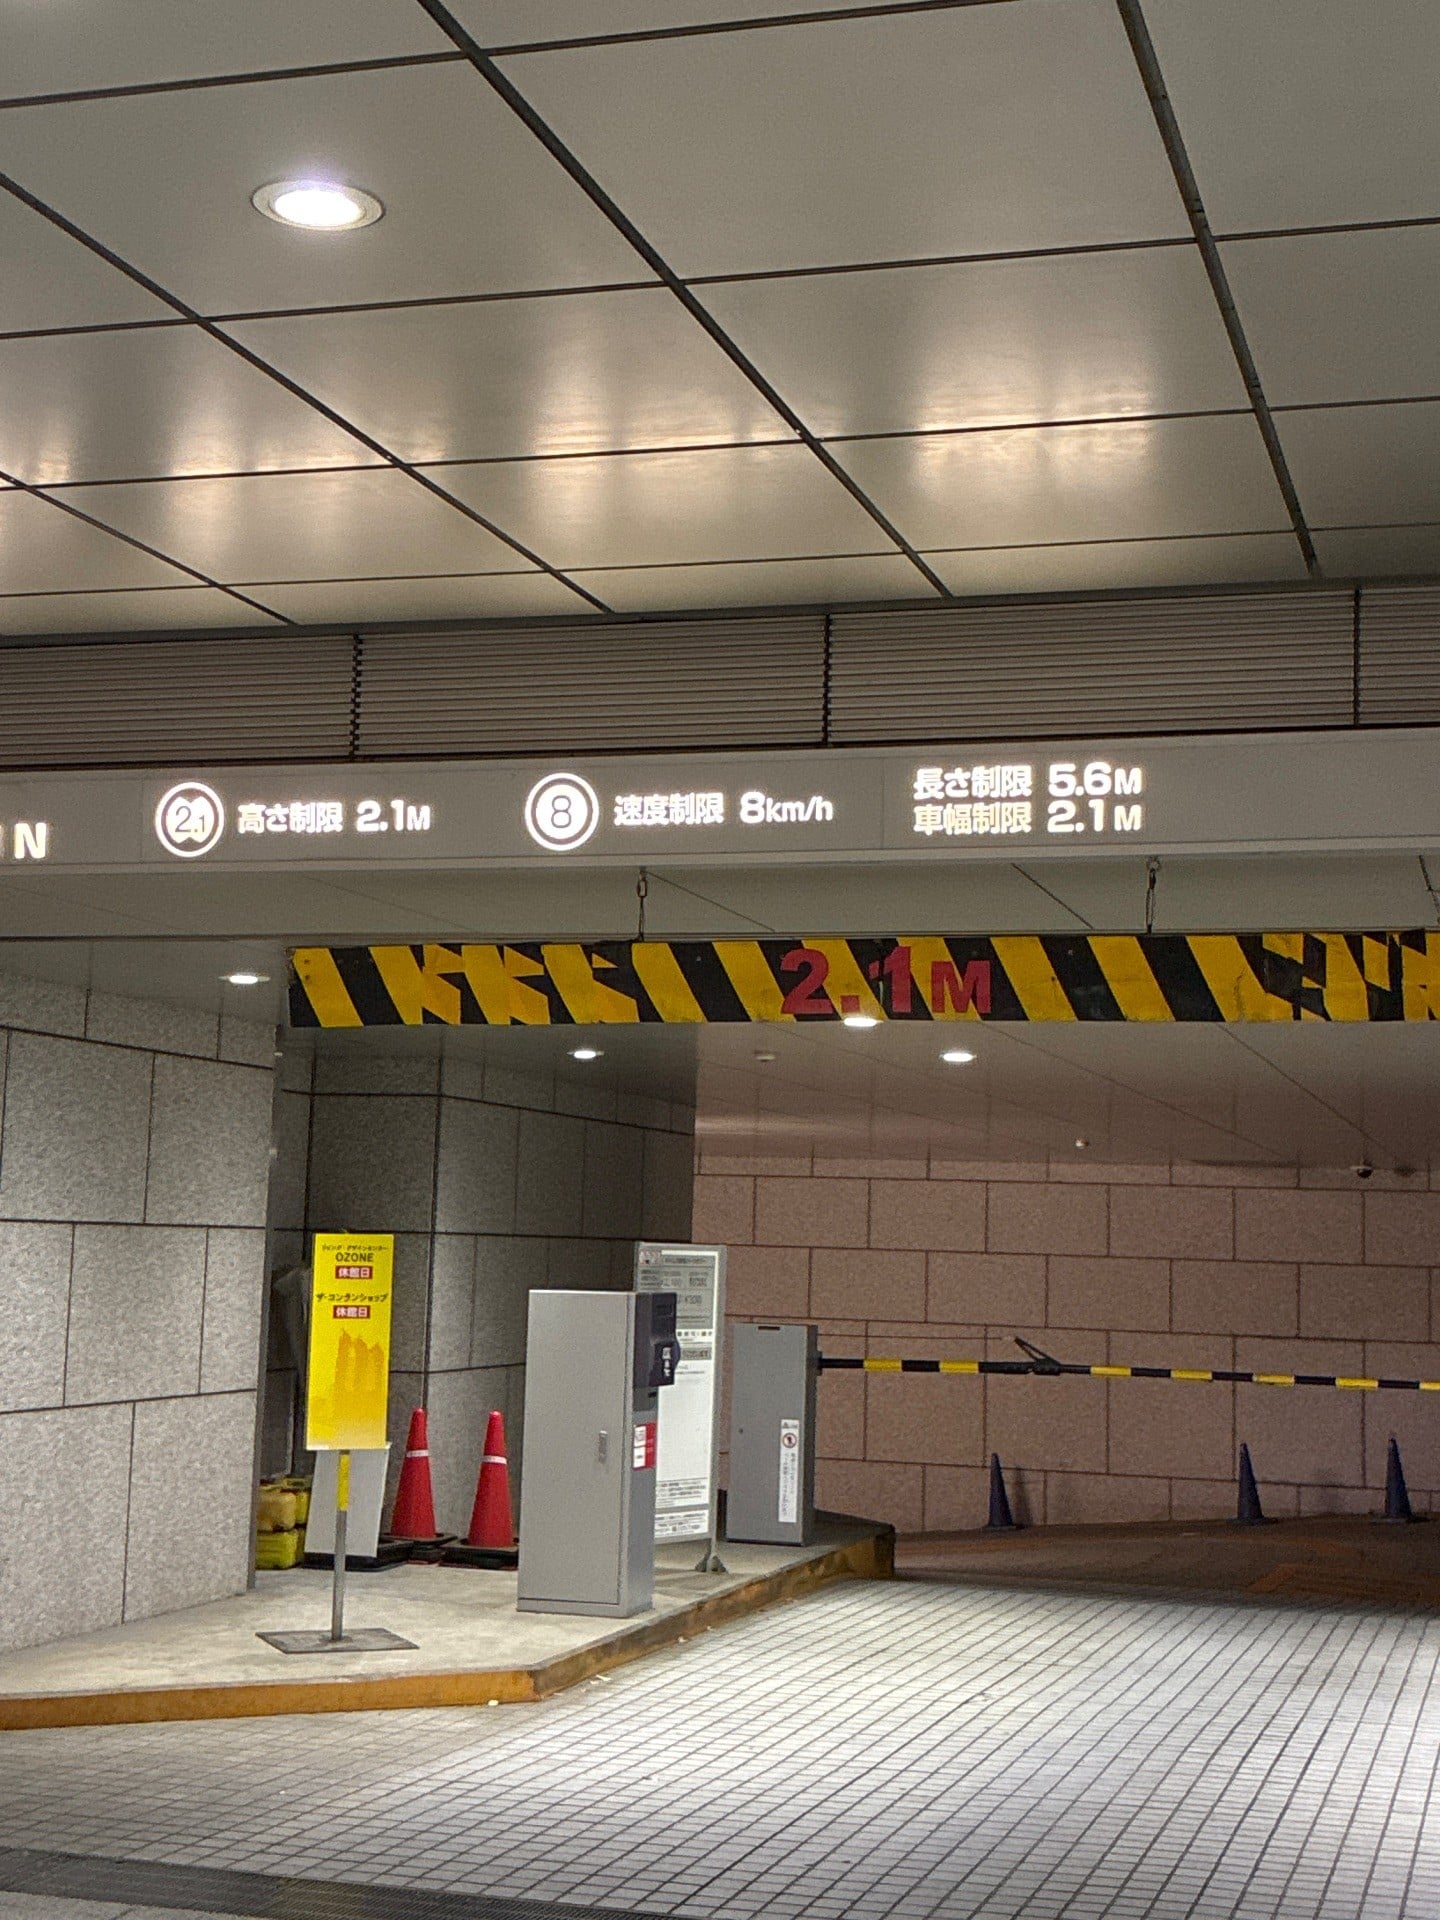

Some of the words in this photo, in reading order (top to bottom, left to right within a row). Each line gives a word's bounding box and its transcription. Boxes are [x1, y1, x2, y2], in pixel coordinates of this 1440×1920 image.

[912, 764, 1033, 800] 長さ制限
[1048, 762, 1143, 798] 5.6M
[174, 804, 208, 834] 2.1
[237, 802, 344, 834] 高さ制限
[356, 799, 431, 833] 2.1M
[551, 794, 571, 829] 8
[613, 791, 725, 827] 速度制限
[739, 790, 834, 824] 8km/h
[912, 801, 1033, 836] 車幅制限
[780, 945, 992, 1014] 2.1M
[335, 1252, 375, 1263] OZONE
